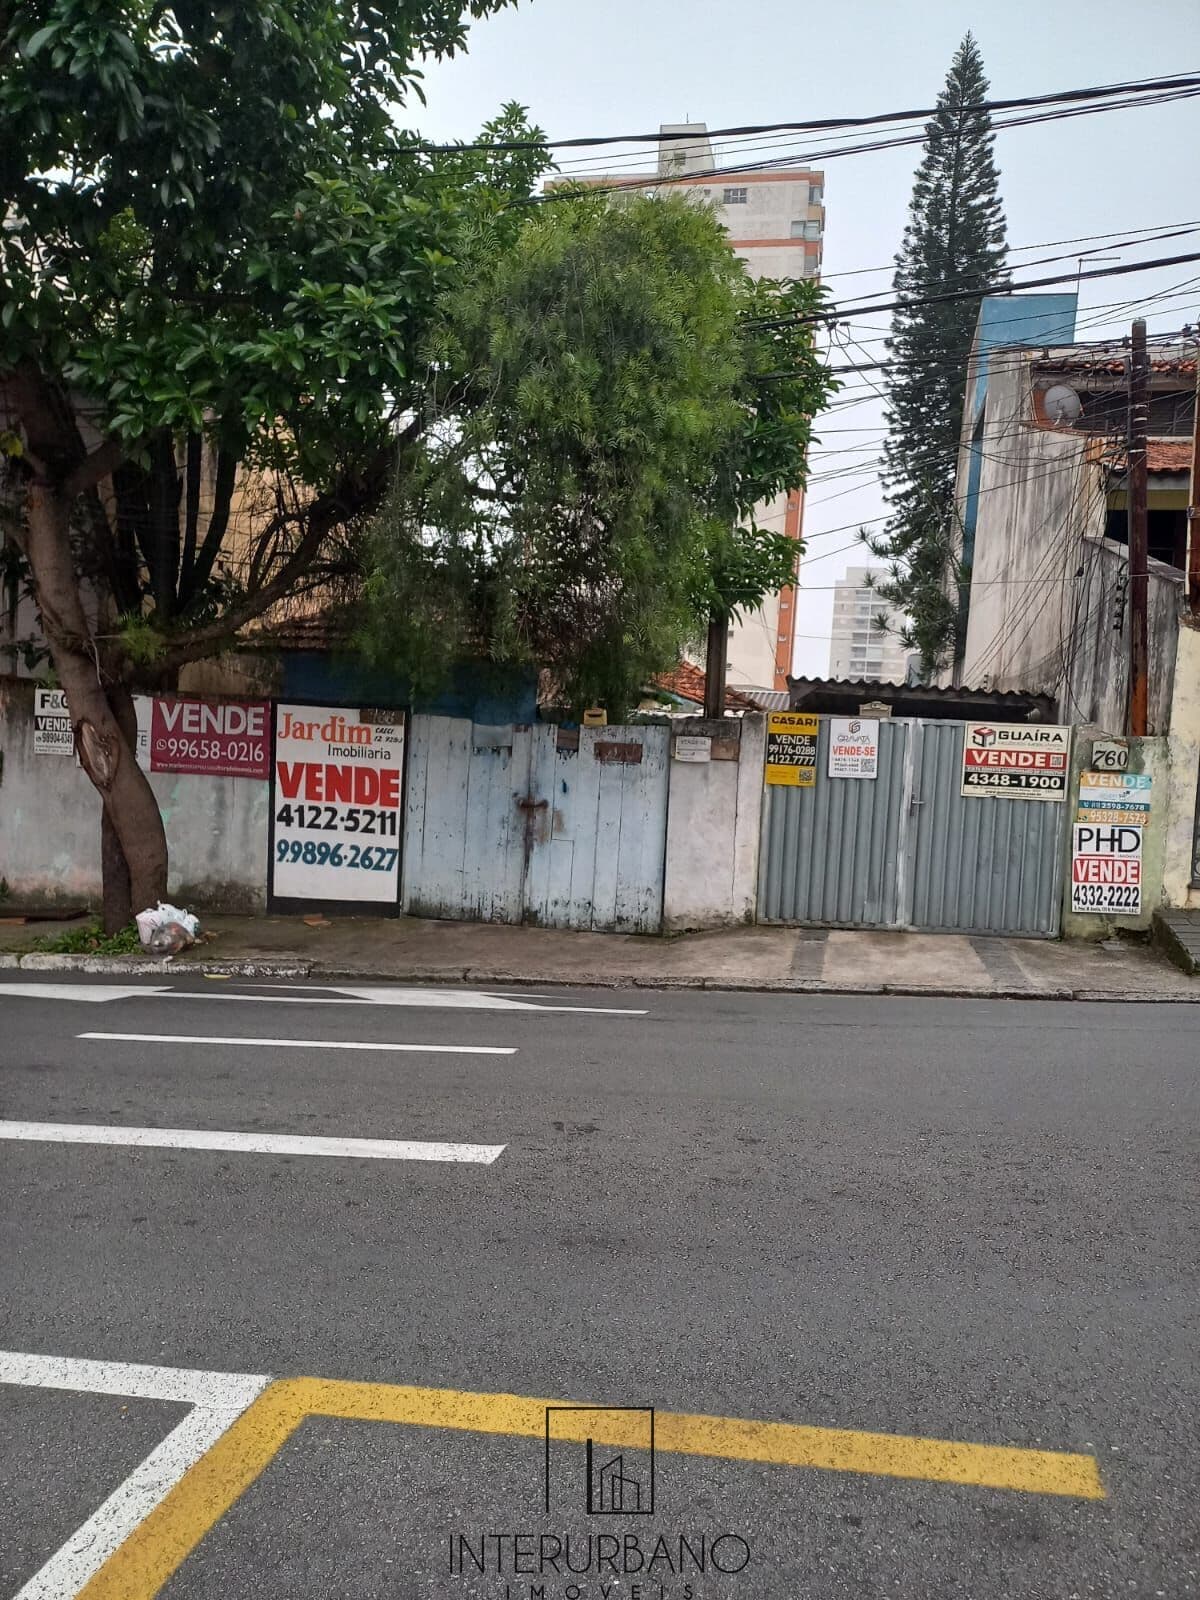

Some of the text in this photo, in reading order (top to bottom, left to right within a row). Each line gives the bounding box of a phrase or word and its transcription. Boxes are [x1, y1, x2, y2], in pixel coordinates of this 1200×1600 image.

[37, 717, 73, 731] VENDE
[158, 701, 266, 737] VENDE
[771, 715, 818, 727] CASARI
[278, 712, 373, 745] Jardim
[998, 729, 1064, 743] GUAÍRA
[775, 734, 811, 745] VENDE
[167, 737, 264, 763] 9.9658-0216
[327, 743, 392, 760] Imobiliaria
[832, 745, 876, 757] VENDE-SE
[971, 750, 1047, 768] VENDE
[1092, 750, 1128, 768] 760
[277, 761, 400, 808] VENDE
[968, 773, 1061, 789] 4348-1900
[1086, 773, 1147, 788] VENDE
[1078, 827, 1141, 853] PHD
[1075, 859, 1138, 884] VENDE
[1073, 884, 1140, 907] 4332-2222
